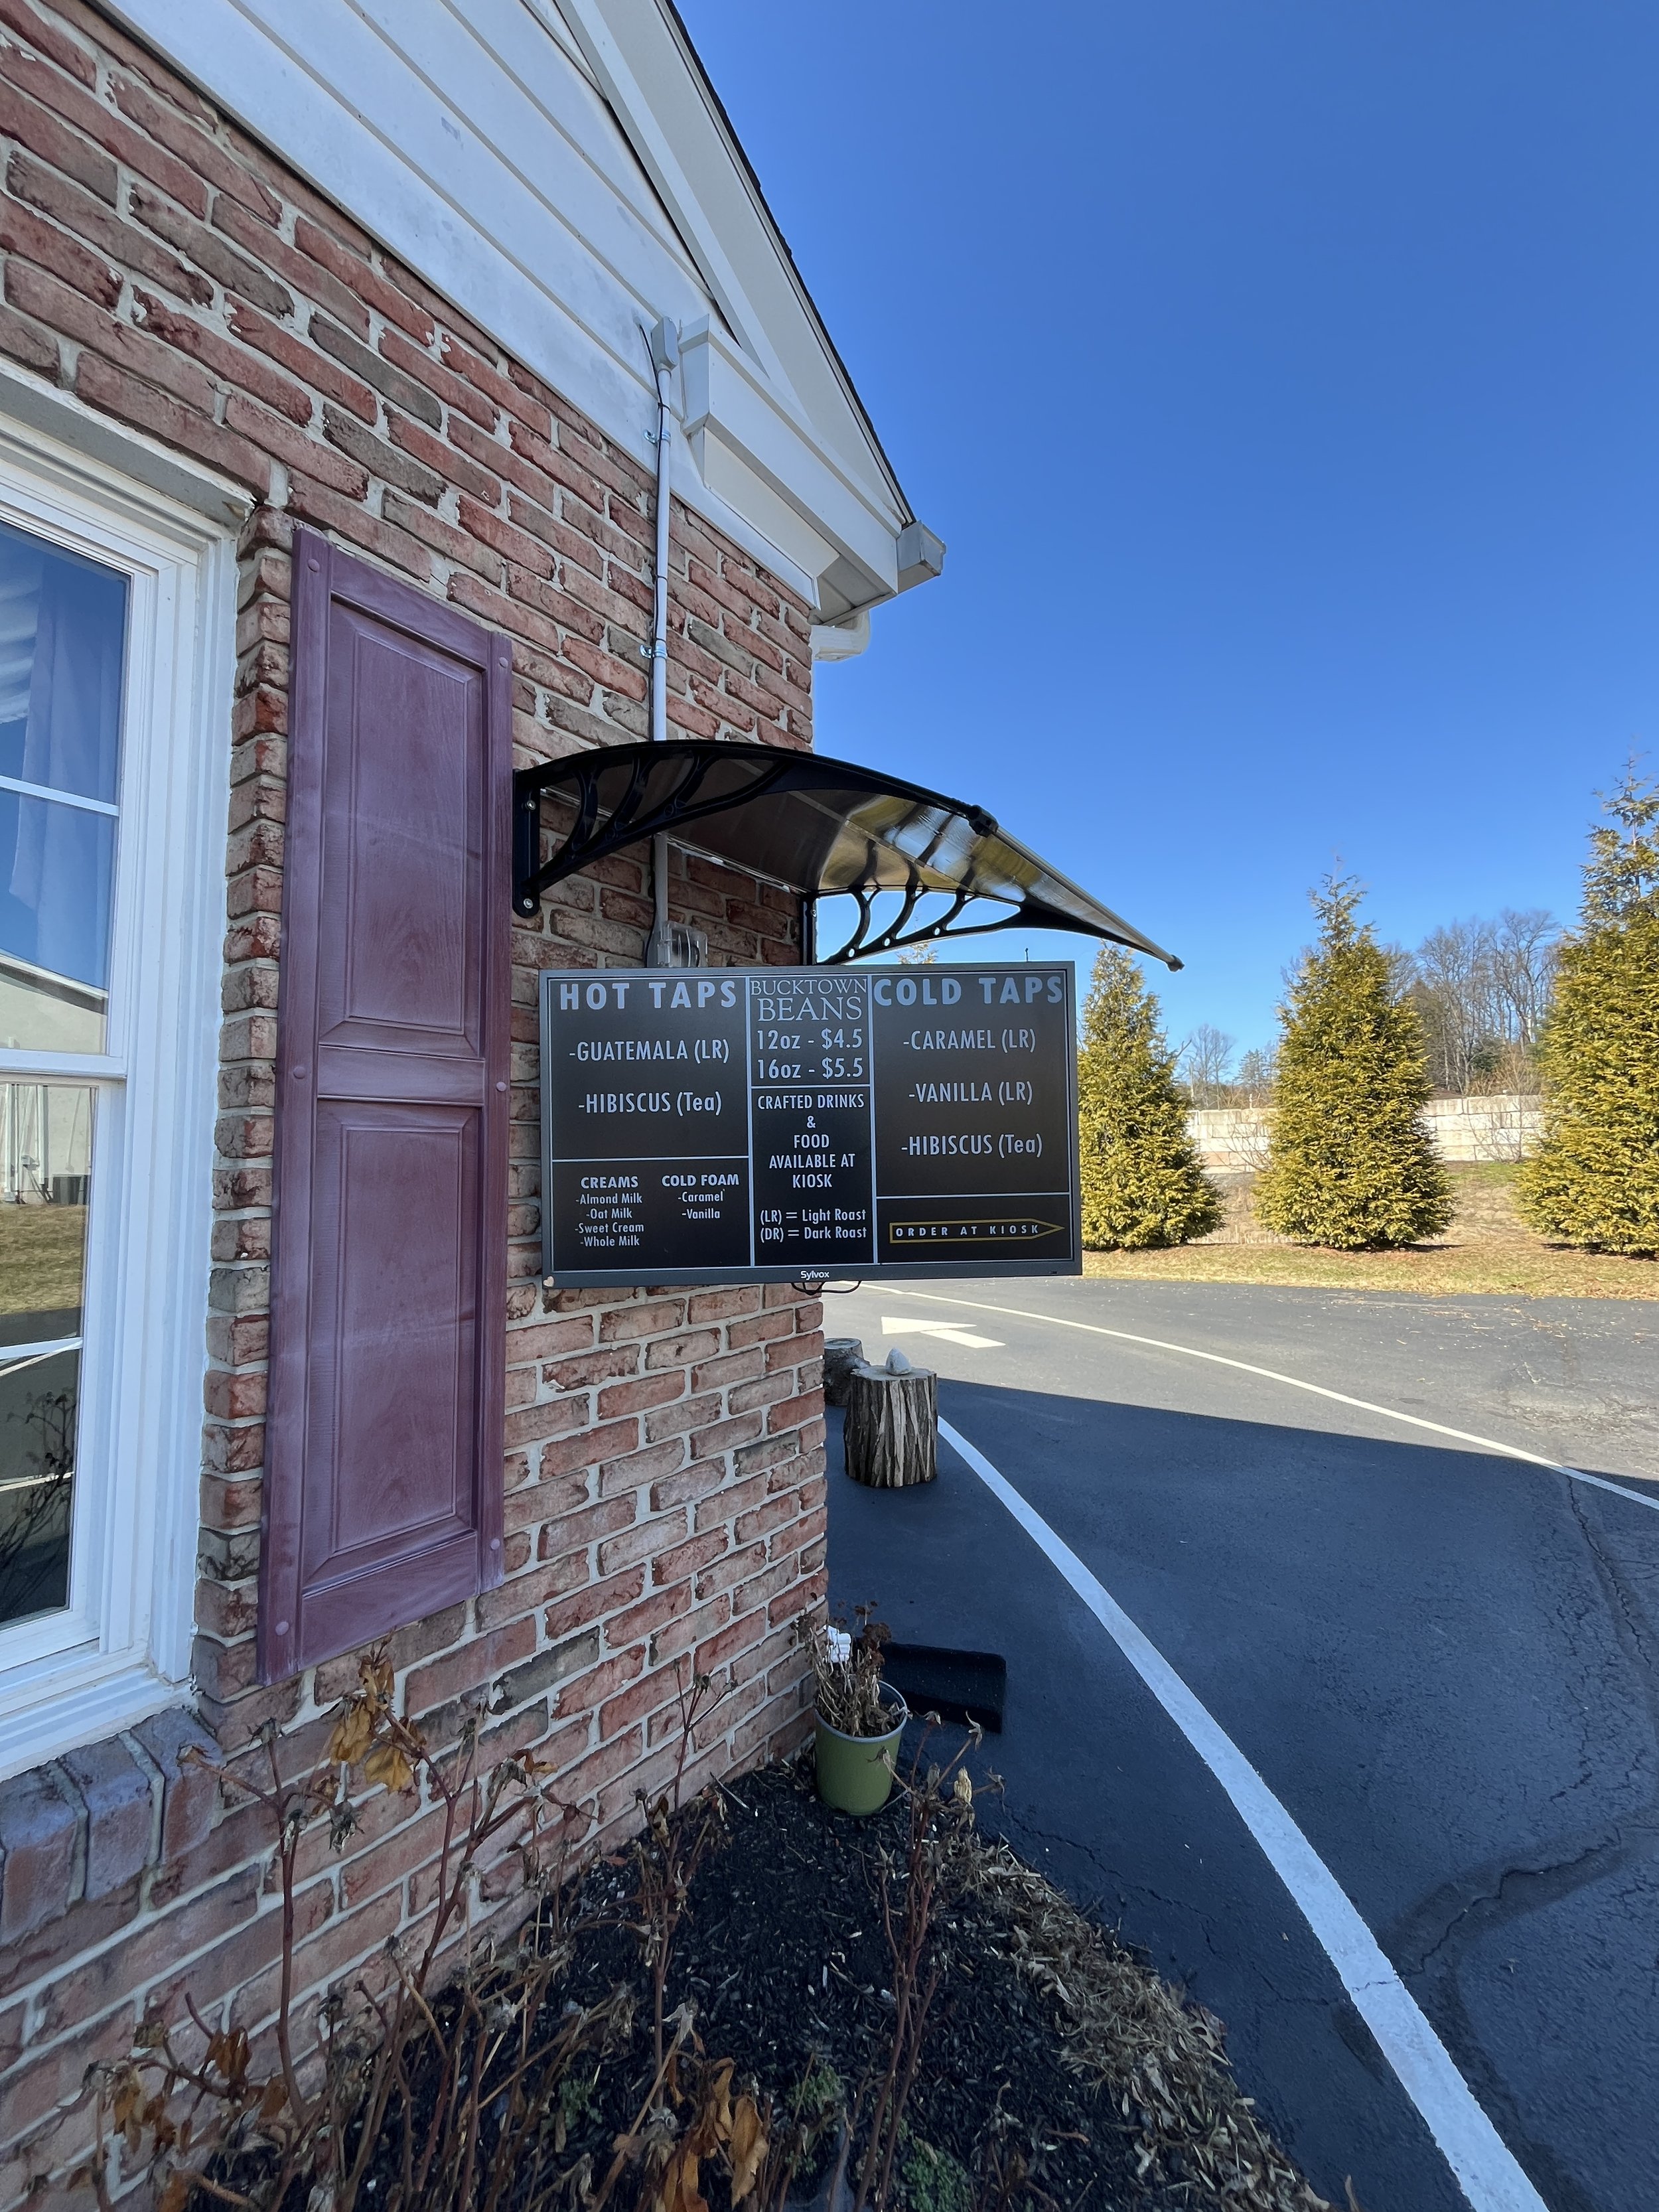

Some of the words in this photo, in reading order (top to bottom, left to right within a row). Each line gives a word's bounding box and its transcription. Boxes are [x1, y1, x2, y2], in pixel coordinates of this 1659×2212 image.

[750, 978, 867, 995] BUCKTOWN
[873, 978, 962, 1006] COLD
[978, 976, 1062, 1004] TAPS
[560, 983, 630, 1010] HOT
[648, 980, 737, 1009] TAPS
[757, 996, 862, 1021] BEANS
[757, 1029, 801, 1050] 12oz
[821, 1027, 862, 1051] $4.5
[903, 1029, 996, 1050] -CARAMEL
[1001, 1029, 1036, 1053] (LR)
[569, 1040, 688, 1061] -GUATEMALA
[694, 1039, 729, 1064] (LR)
[757, 1059, 802, 1079] 16oz
[822, 1057, 863, 1080] $5.5
[758, 1094, 813, 1110] CRAFTED
[817, 1093, 865, 1108] DRINKS
[908, 1082, 993, 1103] -VANILLA
[998, 1081, 1033, 1106] (LR)
[578, 1092, 671, 1114] -HIBISCUS
[676, 1091, 722, 1117] (Tea)
[806, 1115, 816, 1128] &
[794, 1134, 830, 1149] FOOD
[901, 1134, 993, 1155] -HIBISCUS
[998, 1133, 1043, 1159] (Tea)
[768, 1153, 836, 1169] AVAILABLE
[840, 1153, 855, 1167] AT
[581, 1175, 638, 1189] CREAMS
[662, 1175, 697, 1187] COLD
[701, 1173, 739, 1186] FOAM
[792, 1173, 833, 1189] KIOSK
[575, 1193, 618, 1205] -Almond
[621, 1192, 643, 1204] Milk
[678, 1191, 724, 1203] -Caramel
[586, 1208, 609, 1219] -Oat
[611, 1207, 633, 1219] Milk
[682, 1207, 721, 1219] -Vanilla
[760, 1209, 782, 1226] (LR)
[802, 1208, 831, 1224] Light
[834, 1208, 867, 1221] Roast
[575, 1222, 609, 1234] -Sweet
[612, 1221, 644, 1233] Cream
[760, 1226, 784, 1244] (DR)
[804, 1226, 831, 1240] Dark
[835, 1226, 867, 1239] Roast
[895, 1226, 949, 1237] ORDER
[960, 1226, 977, 1236] AT
[989, 1224, 1039, 1234] KIOSK
[580, 1235, 615, 1247] -Whole
[618, 1234, 640, 1246] Milk
[800, 1270, 830, 1281] Sylvox
